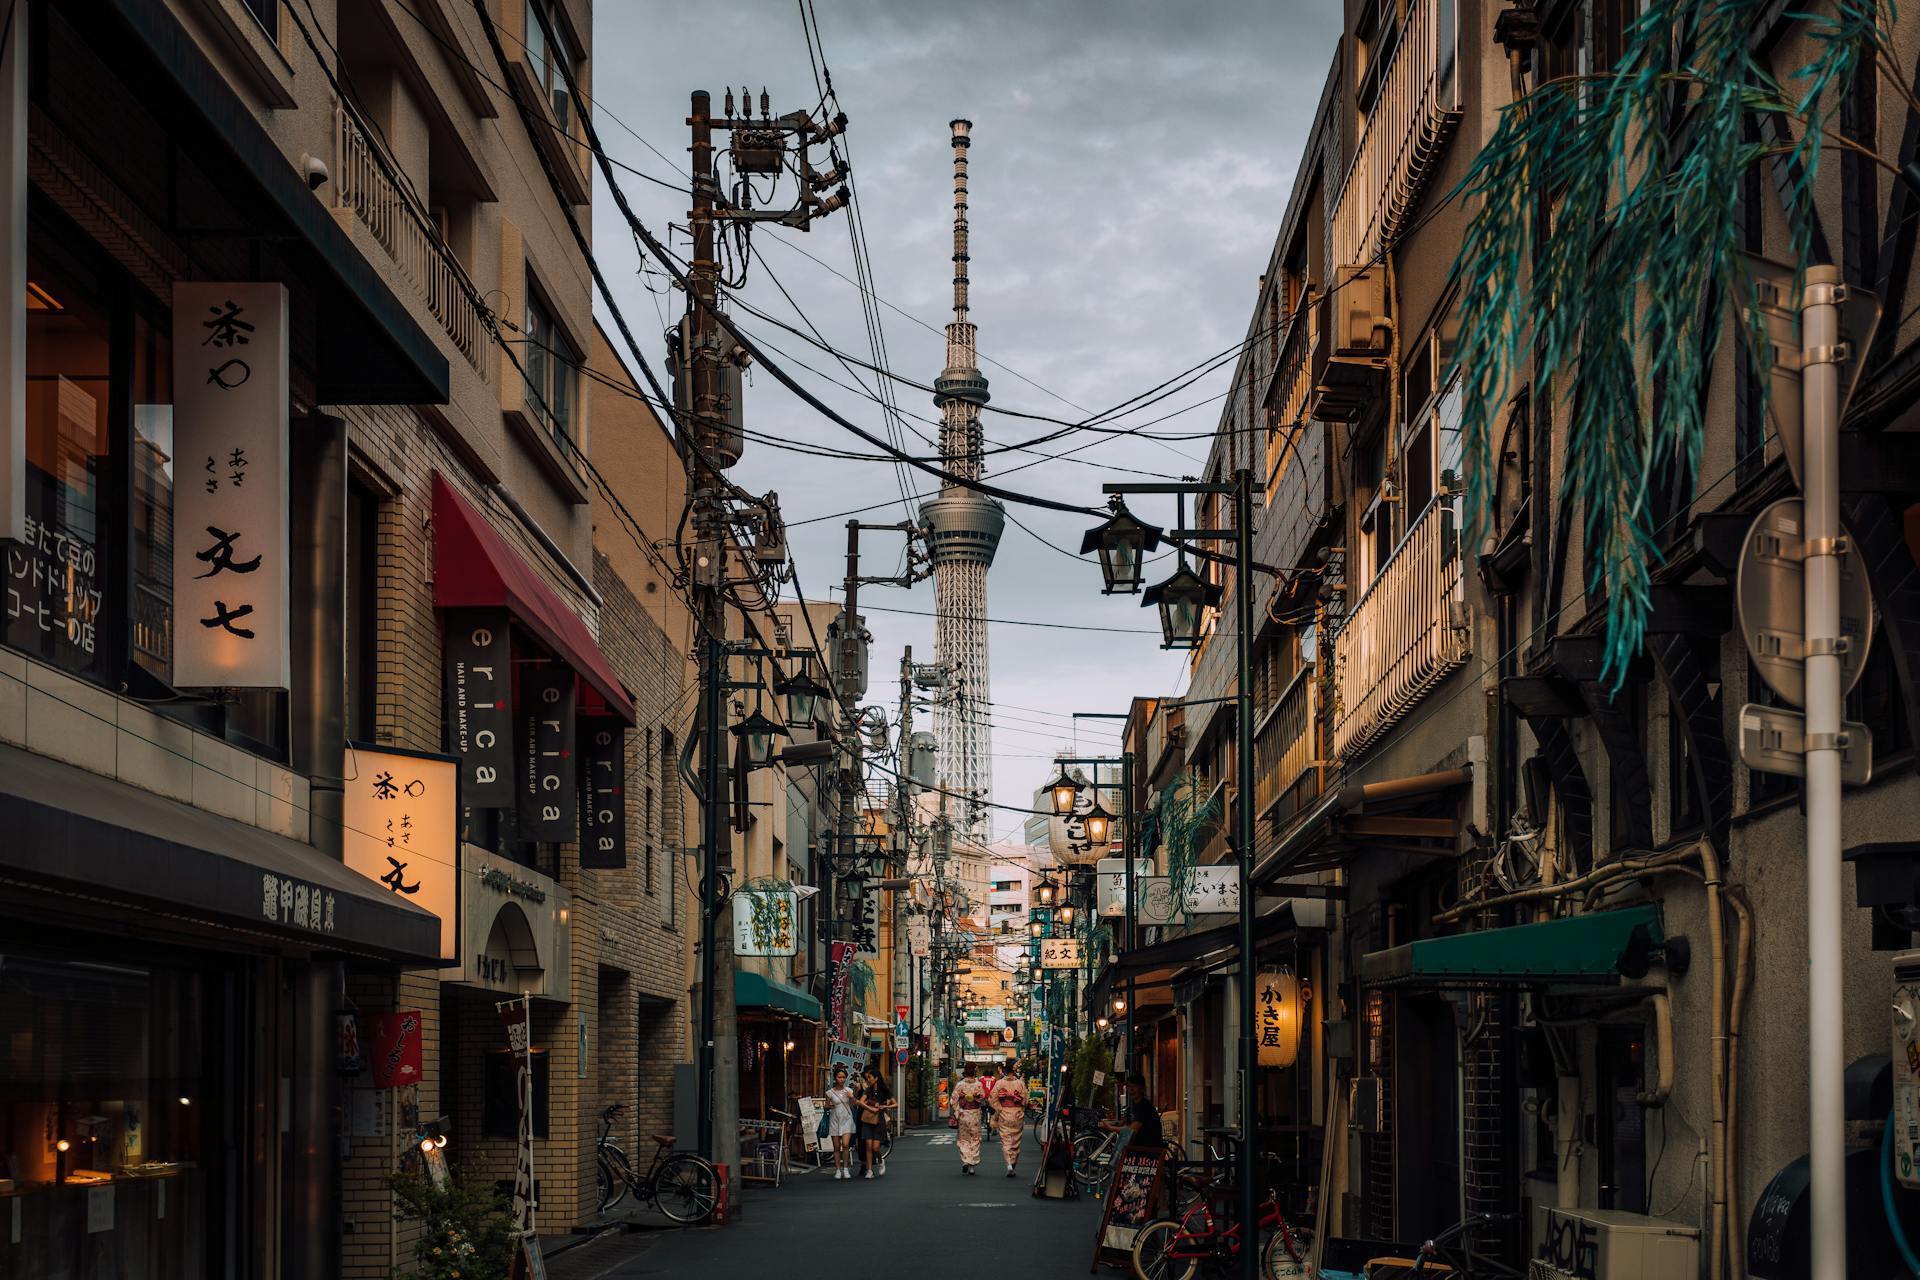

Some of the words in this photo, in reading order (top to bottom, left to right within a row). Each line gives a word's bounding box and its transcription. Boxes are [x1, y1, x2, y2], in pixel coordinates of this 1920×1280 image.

[202, 301, 255, 391] 茶や
[25, 514, 96, 577] きたて豆の
[194, 524, 262, 638] 文七
[8, 587, 96, 654] コーヒーの店
[457, 662, 465, 685] HAIR
[458, 687, 466, 708] AND
[458, 708, 468, 753] MAKE-UP
[471, 627, 506, 784] erica
[372, 771, 425, 800] 茶や
[529, 757, 537, 795] MAKE-UP
[542, 687, 571, 821] erica
[597, 731, 622, 851] erica
[380, 856, 421, 894] 文
[382, 1016, 418, 1080] おしるこ
[1260, 985, 1282, 1048] かき屋
